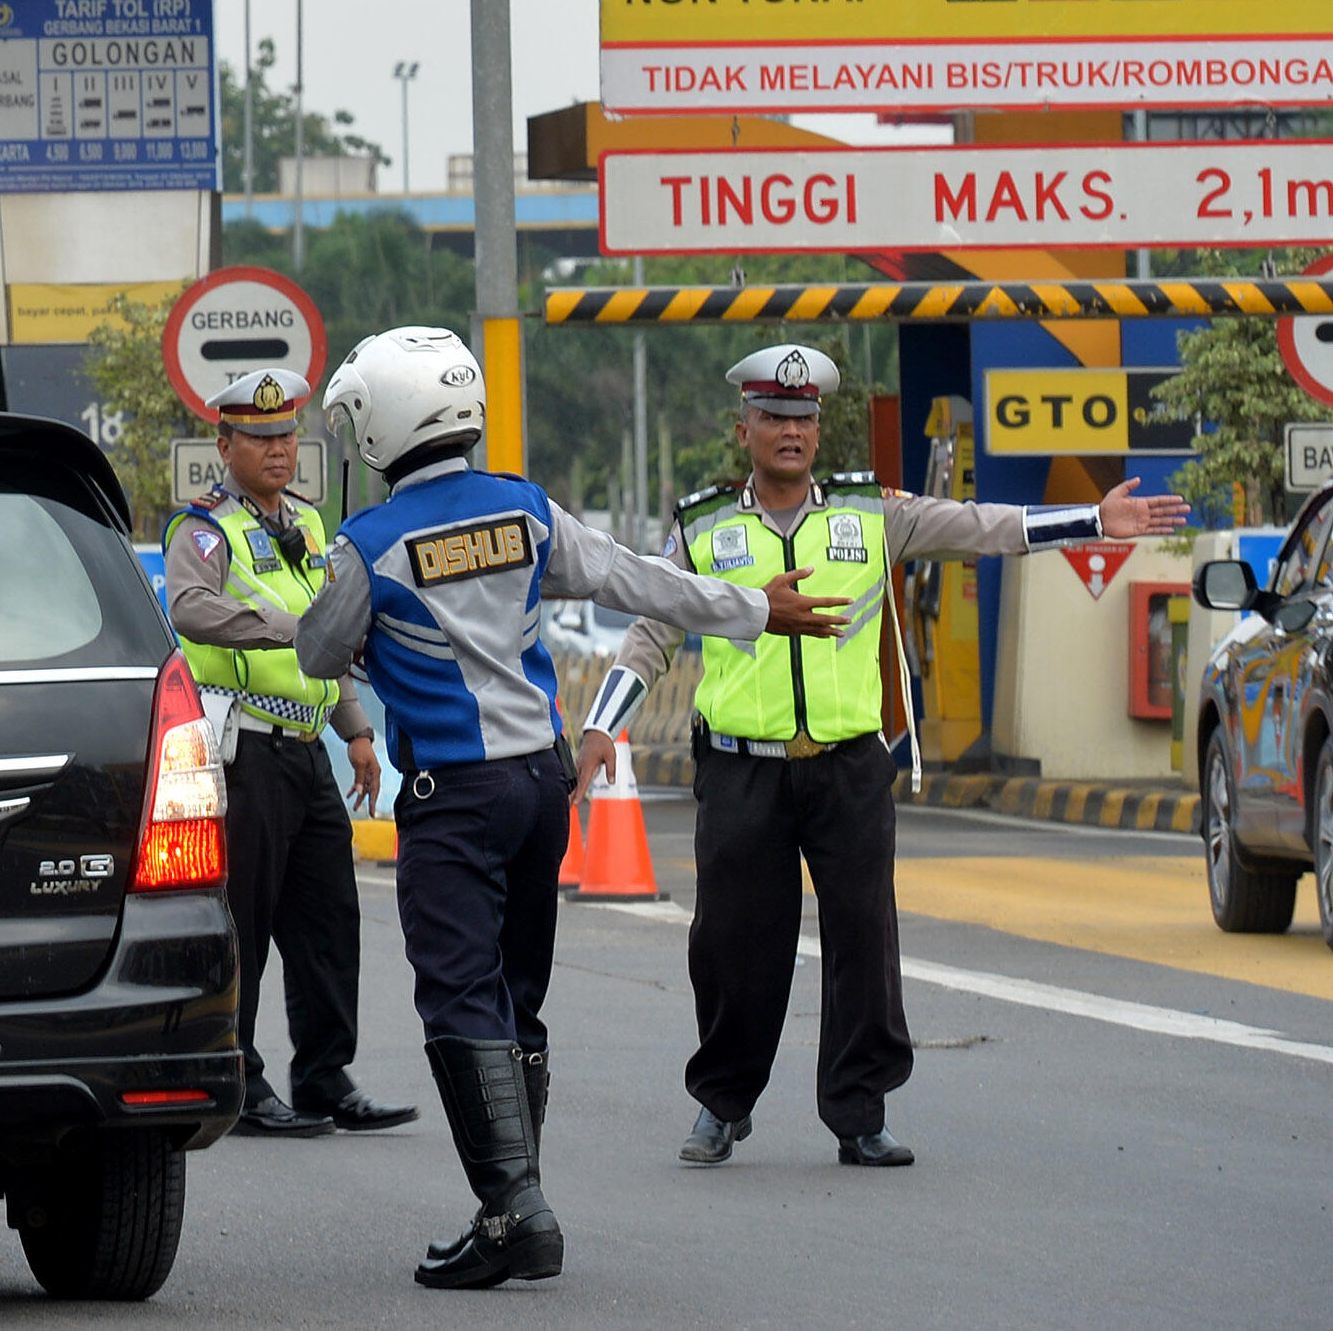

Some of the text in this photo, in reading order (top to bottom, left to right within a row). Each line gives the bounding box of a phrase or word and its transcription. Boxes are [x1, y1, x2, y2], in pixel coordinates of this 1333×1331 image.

[55, 0, 107, 18] TARIF
[112, 0, 148, 17] TOL
[44, 20, 103, 36] GERBANG
[106, 20, 150, 34] BEKASI
[152, 19, 193, 33] BARAT
[52, 40, 195, 66] GOLONGAN
[148, 75, 167, 90] IV
[186, 74, 197, 89] V
[642, 65, 748, 93] TIDAK
[759, 63, 933, 91] MELAYANI
[661, 171, 858, 228] TINGGI
[933, 169, 1128, 224] MAKS.
[192, 310, 294, 331] GERBANG
[995, 395, 1117, 429] GTO
[415, 524, 524, 581] DISHUB
[829, 548, 866, 562] POLISI
[39, 860, 75, 876] 2.0
[30, 879, 102, 895] LUXURY
